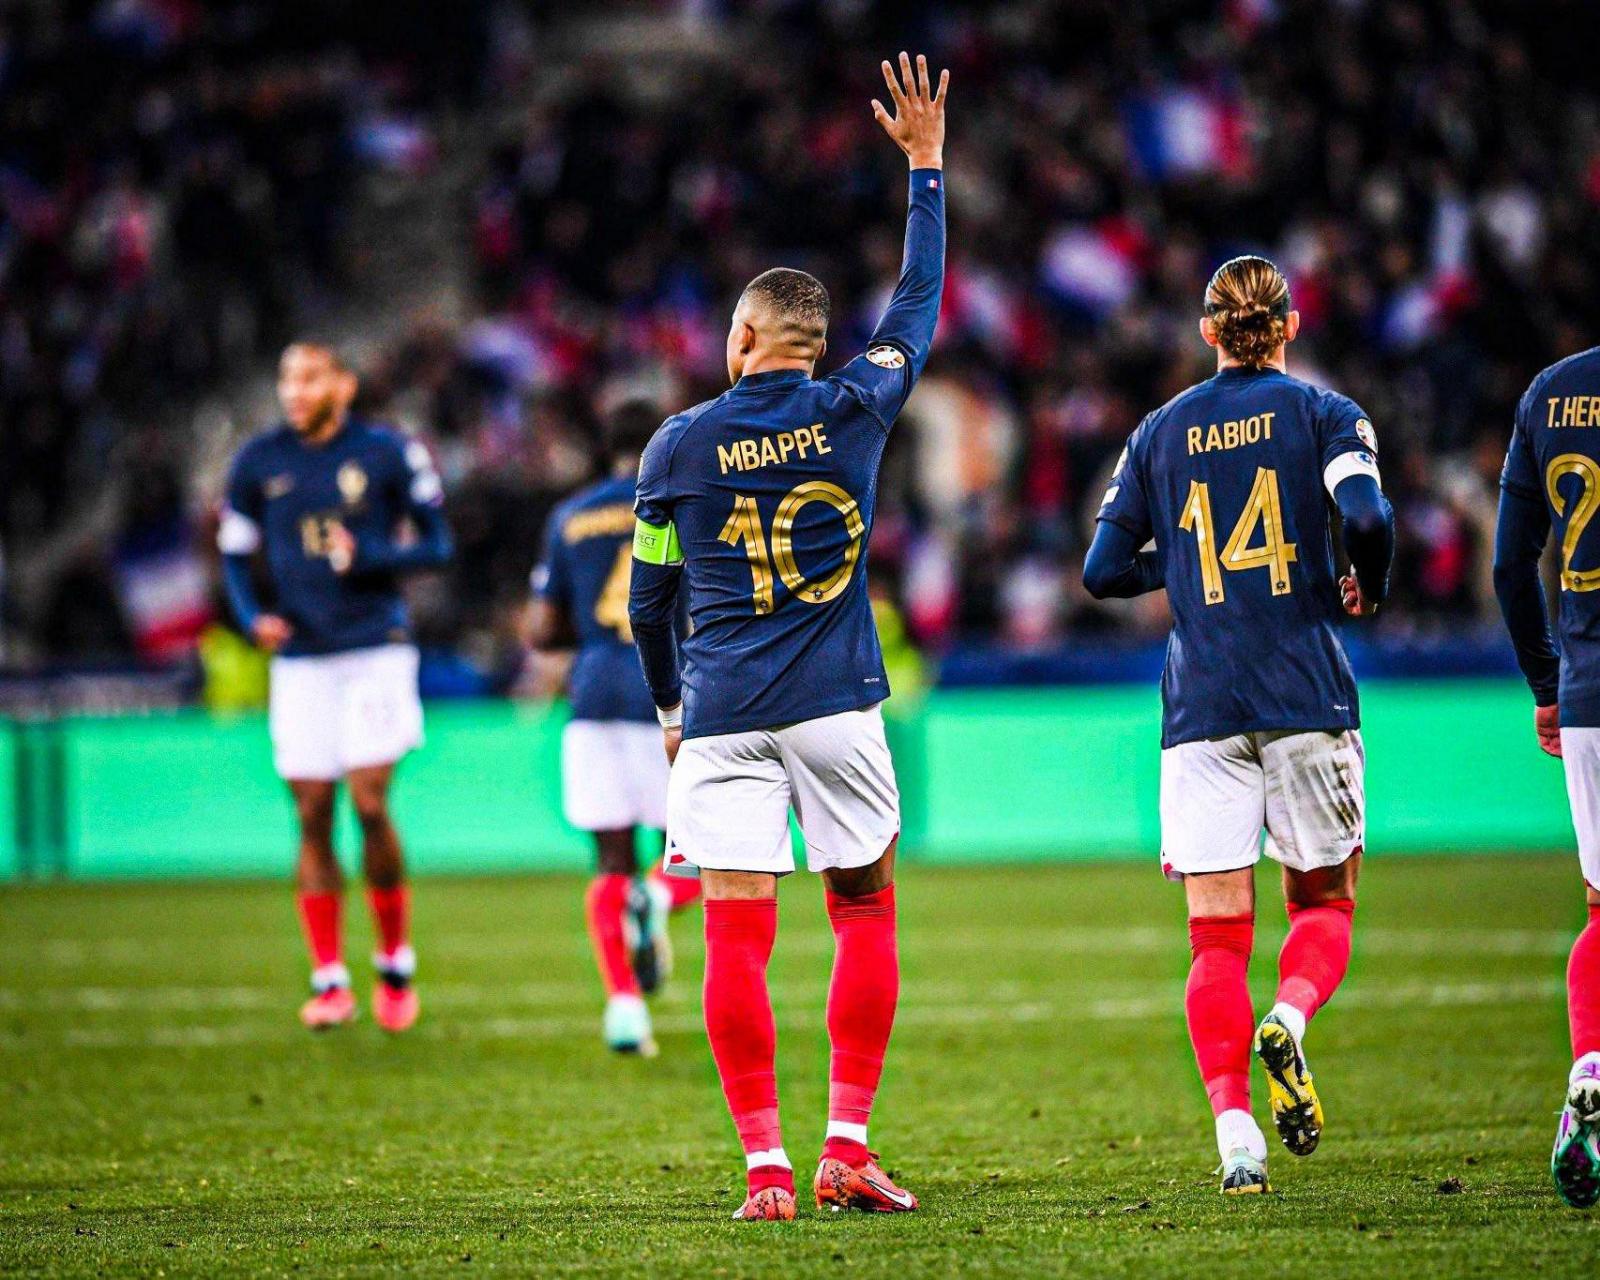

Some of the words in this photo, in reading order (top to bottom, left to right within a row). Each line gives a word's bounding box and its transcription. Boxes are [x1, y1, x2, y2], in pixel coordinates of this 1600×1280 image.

[717, 423, 832, 474] MBAPPE
[1187, 412, 1275, 456] RABIOT
[1548, 396, 1600, 428] T.HER
[717, 480, 864, 614] 10
[1178, 467, 1297, 605] 14
[1546, 453, 1600, 592] 2
